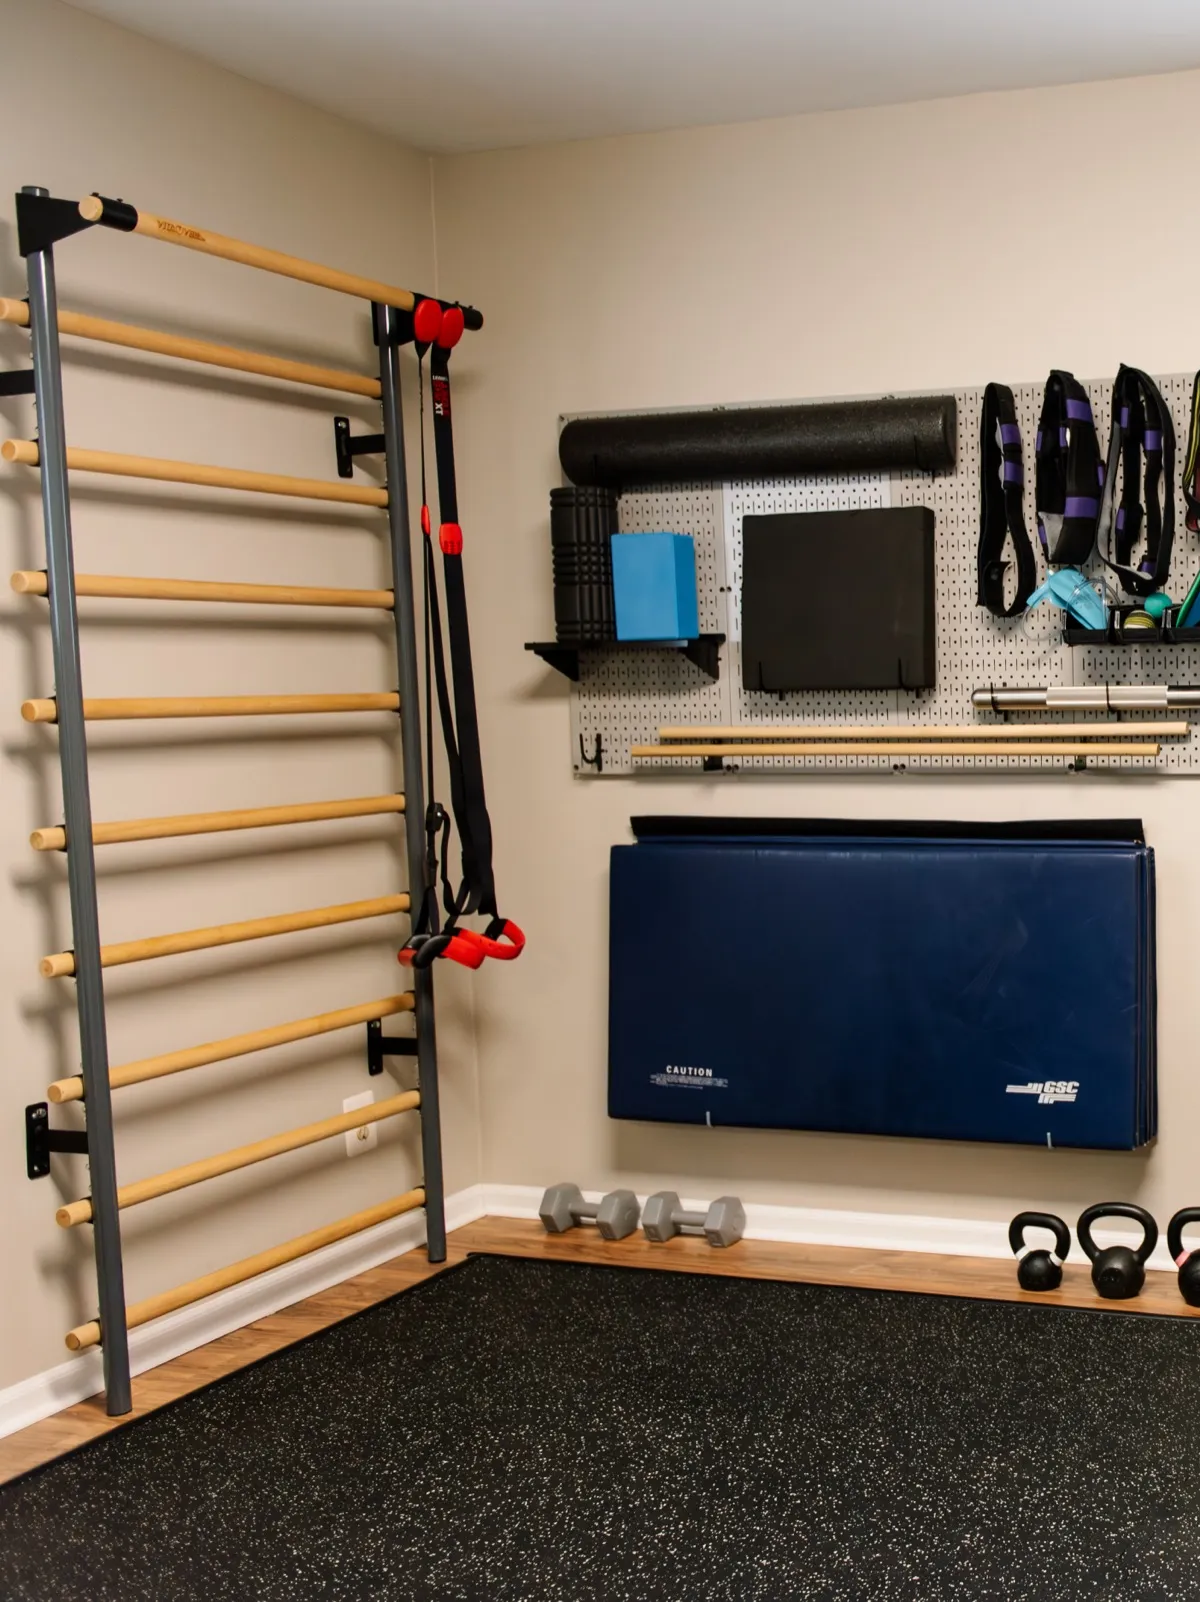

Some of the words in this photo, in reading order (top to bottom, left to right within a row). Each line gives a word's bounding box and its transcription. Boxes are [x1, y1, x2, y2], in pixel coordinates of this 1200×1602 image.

[435, 402, 444, 416] XT
[665, 1064, 713, 1078] CAUTION
[1043, 1080, 1080, 1094] GSC
